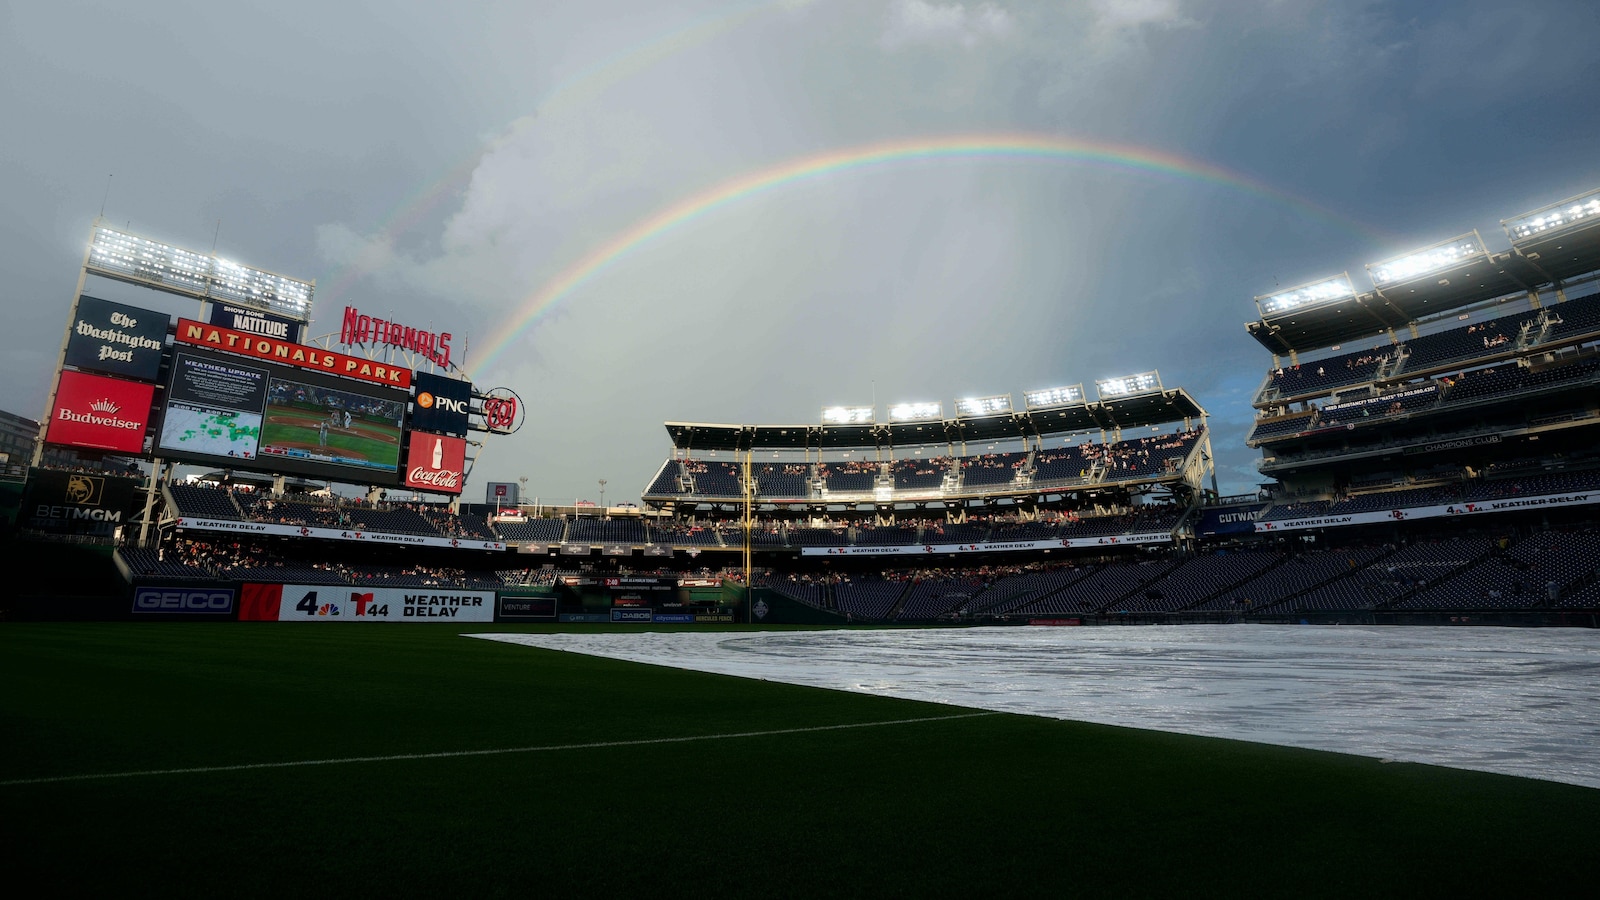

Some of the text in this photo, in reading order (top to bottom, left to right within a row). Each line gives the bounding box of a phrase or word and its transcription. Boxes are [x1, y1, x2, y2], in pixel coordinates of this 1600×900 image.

[224, 306, 244, 315] SHOW
[110, 312, 137, 328] The
[234, 314, 288, 337] NATITUDE
[76, 320, 161, 350] Washington
[340, 306, 452, 367] NATIONALS
[98, 345, 133, 362] Post
[187, 325, 402, 382] NATIONALS PARK
[184, 360, 262, 379] WEATHER UPDATE
[435, 396, 467, 414] PNC
[58, 408, 141, 430] Budweiser
[1424, 439, 1473, 452] CHAMPIONS
[1475, 436, 1498, 445] CLUB
[409, 466, 462, 488] Coca-Cola
[1492, 499, 1545, 509] WEATHER
[1549, 494, 1589, 503] DELAY
[36, 504, 122, 523] BETMGM
[196, 521, 237, 529] WEATHER
[138, 592, 230, 608] GEICO
[296, 591, 318, 615] 4
[367, 604, 388, 616] 44
[404, 594, 483, 606] WEATHER
[403, 606, 459, 617] DELAY
